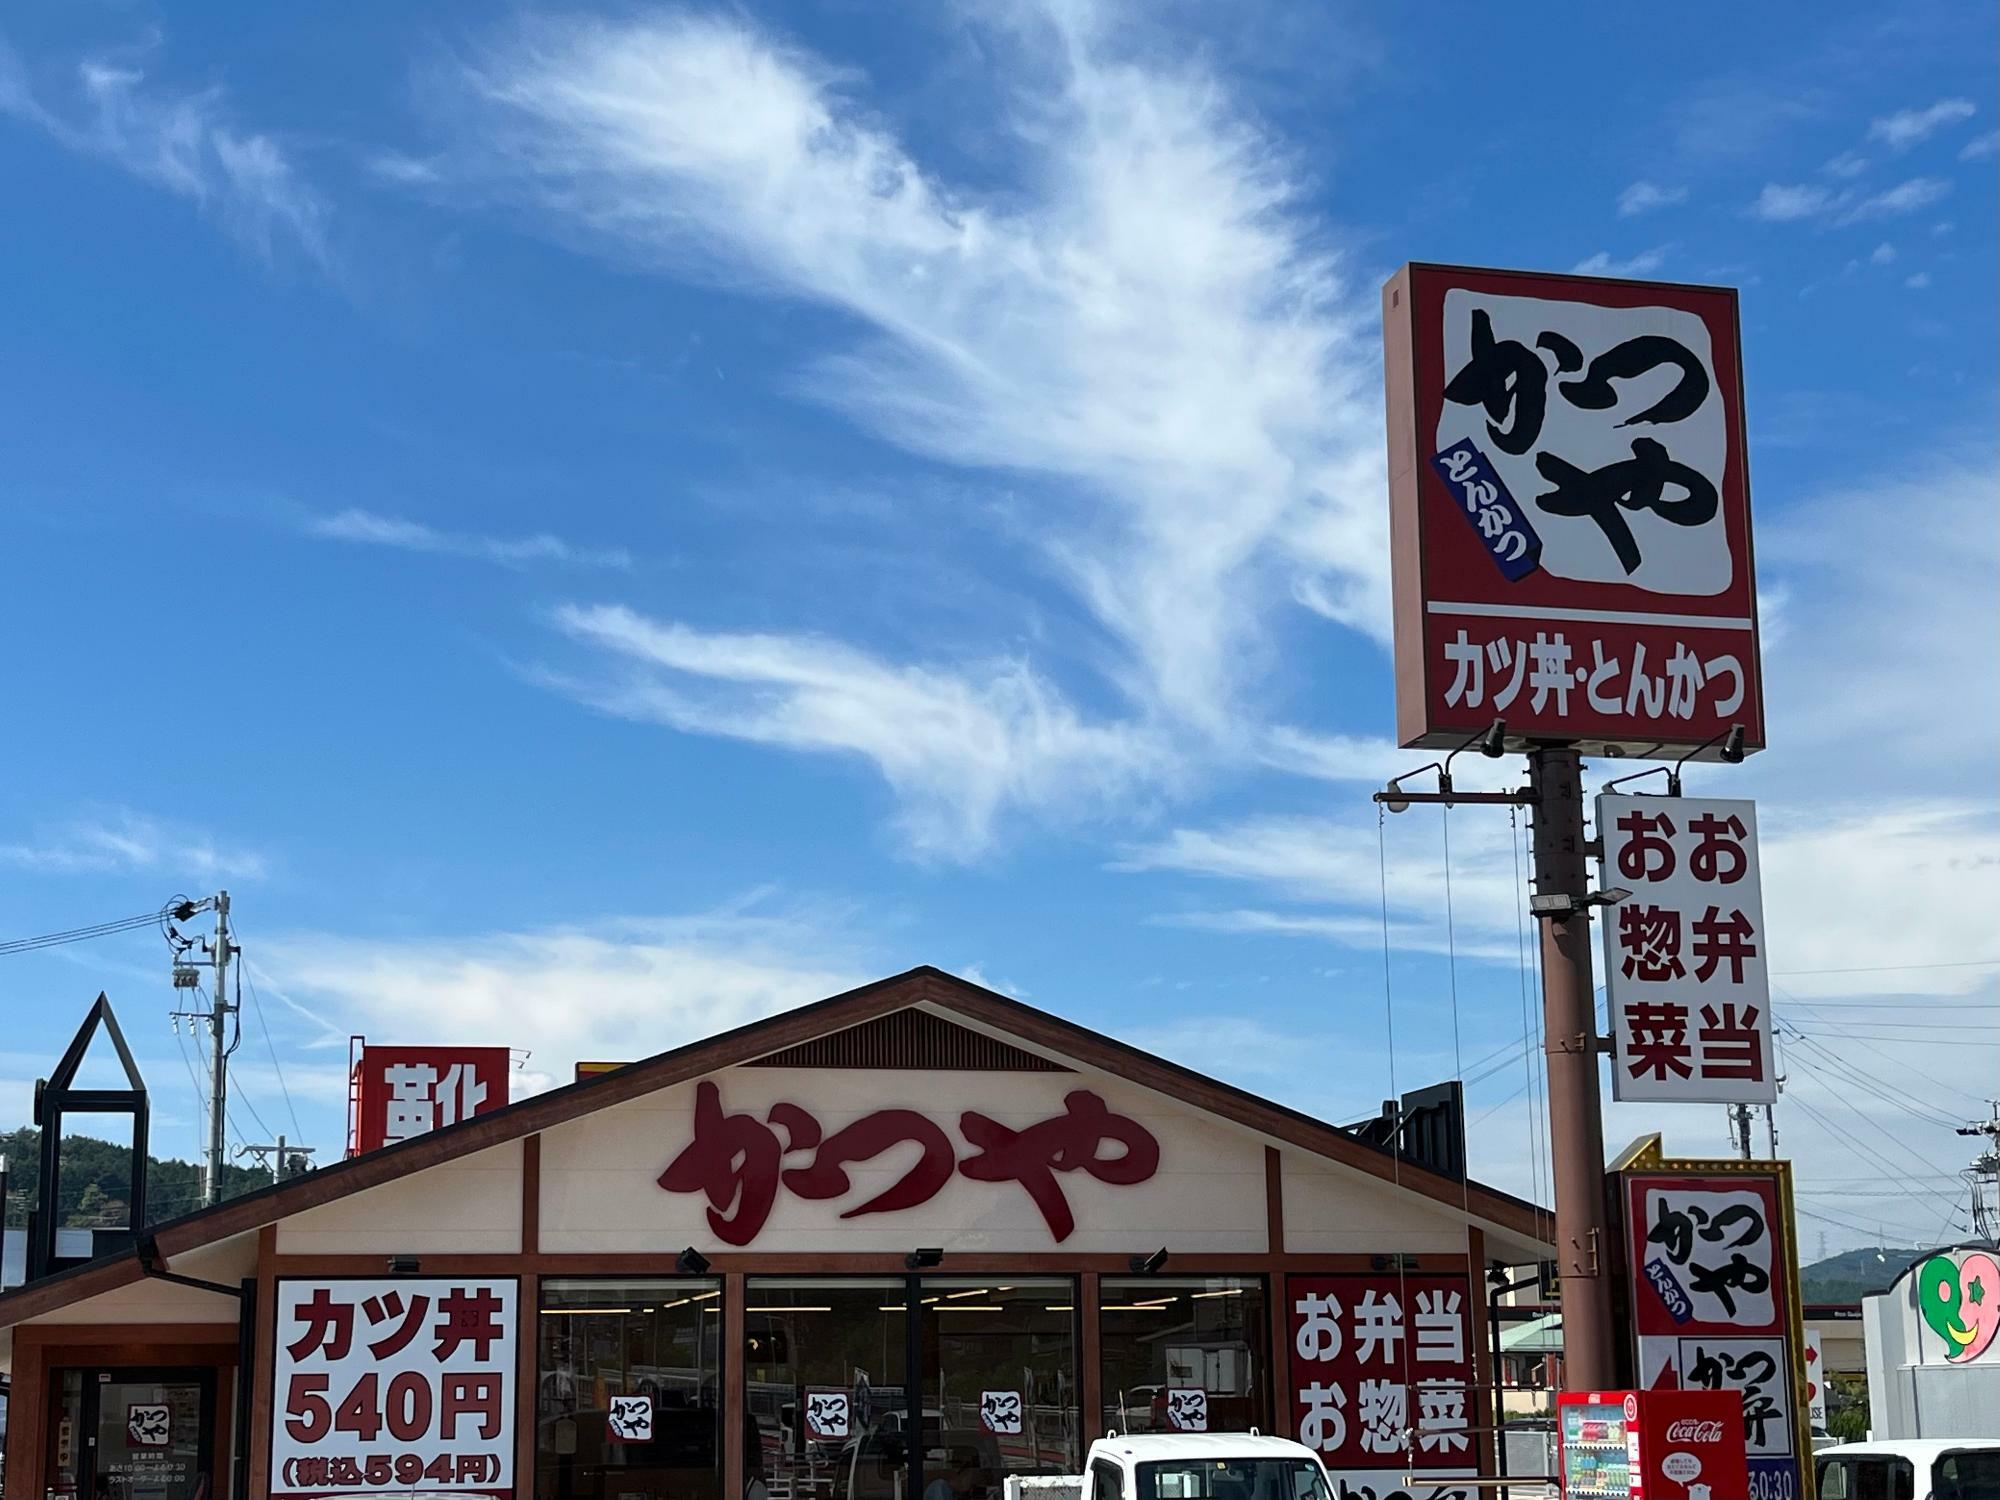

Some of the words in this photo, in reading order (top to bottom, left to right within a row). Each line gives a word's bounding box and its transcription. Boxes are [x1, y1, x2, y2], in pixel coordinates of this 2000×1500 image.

[1440, 450, 1527, 561] とんかつ
[1616, 810, 1694, 1081] お惣菜
[1688, 812, 1764, 1082] お弁当
[657, 1081, 1160, 1246] かつや
[286, 1288, 503, 1363] カツ丼
[1296, 1290, 1464, 1364] お弁当
[1646, 1264, 1687, 1315] とんかつ
[285, 1371, 503, 1444] 540円
[1299, 1378, 1469, 1453] お惣菜
[283, 1454, 501, 1487] (税込594円)
